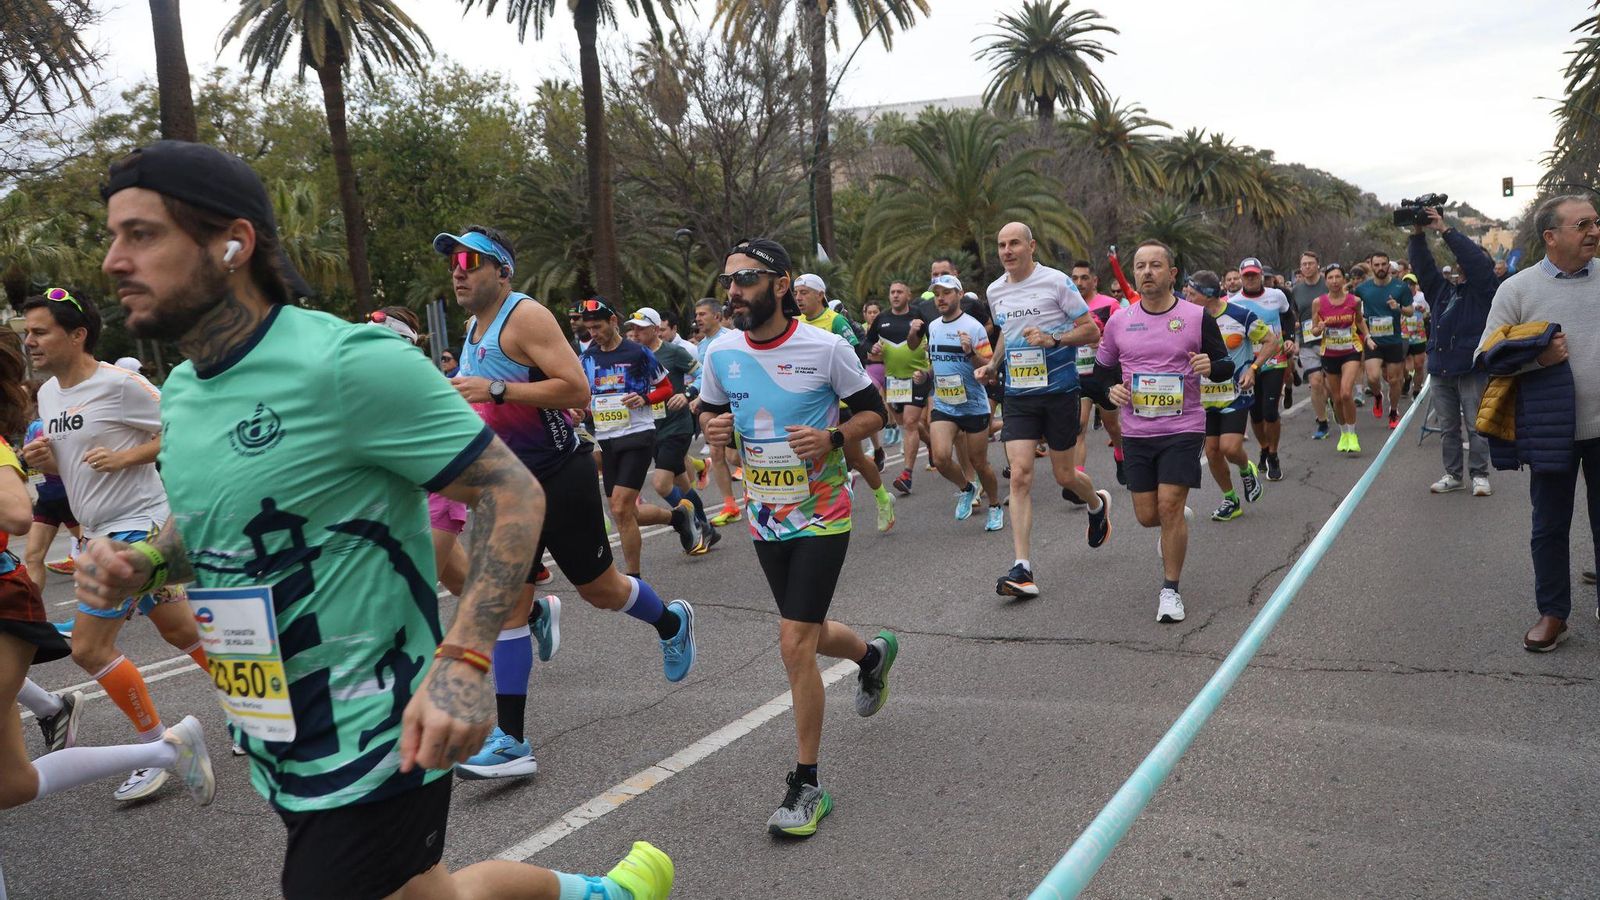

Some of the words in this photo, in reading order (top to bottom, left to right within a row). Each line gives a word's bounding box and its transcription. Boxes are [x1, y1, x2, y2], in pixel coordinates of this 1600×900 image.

[1007, 308, 1040, 318] FIDIAS
[1014, 367, 1040, 377] 1773
[941, 388, 959, 396] 1712
[1205, 386, 1228, 394] 2719
[1143, 395, 1174, 406] 1789
[600, 411, 623, 421] 3559
[49, 411, 84, 433] nike
[752, 470, 794, 486] 2470
